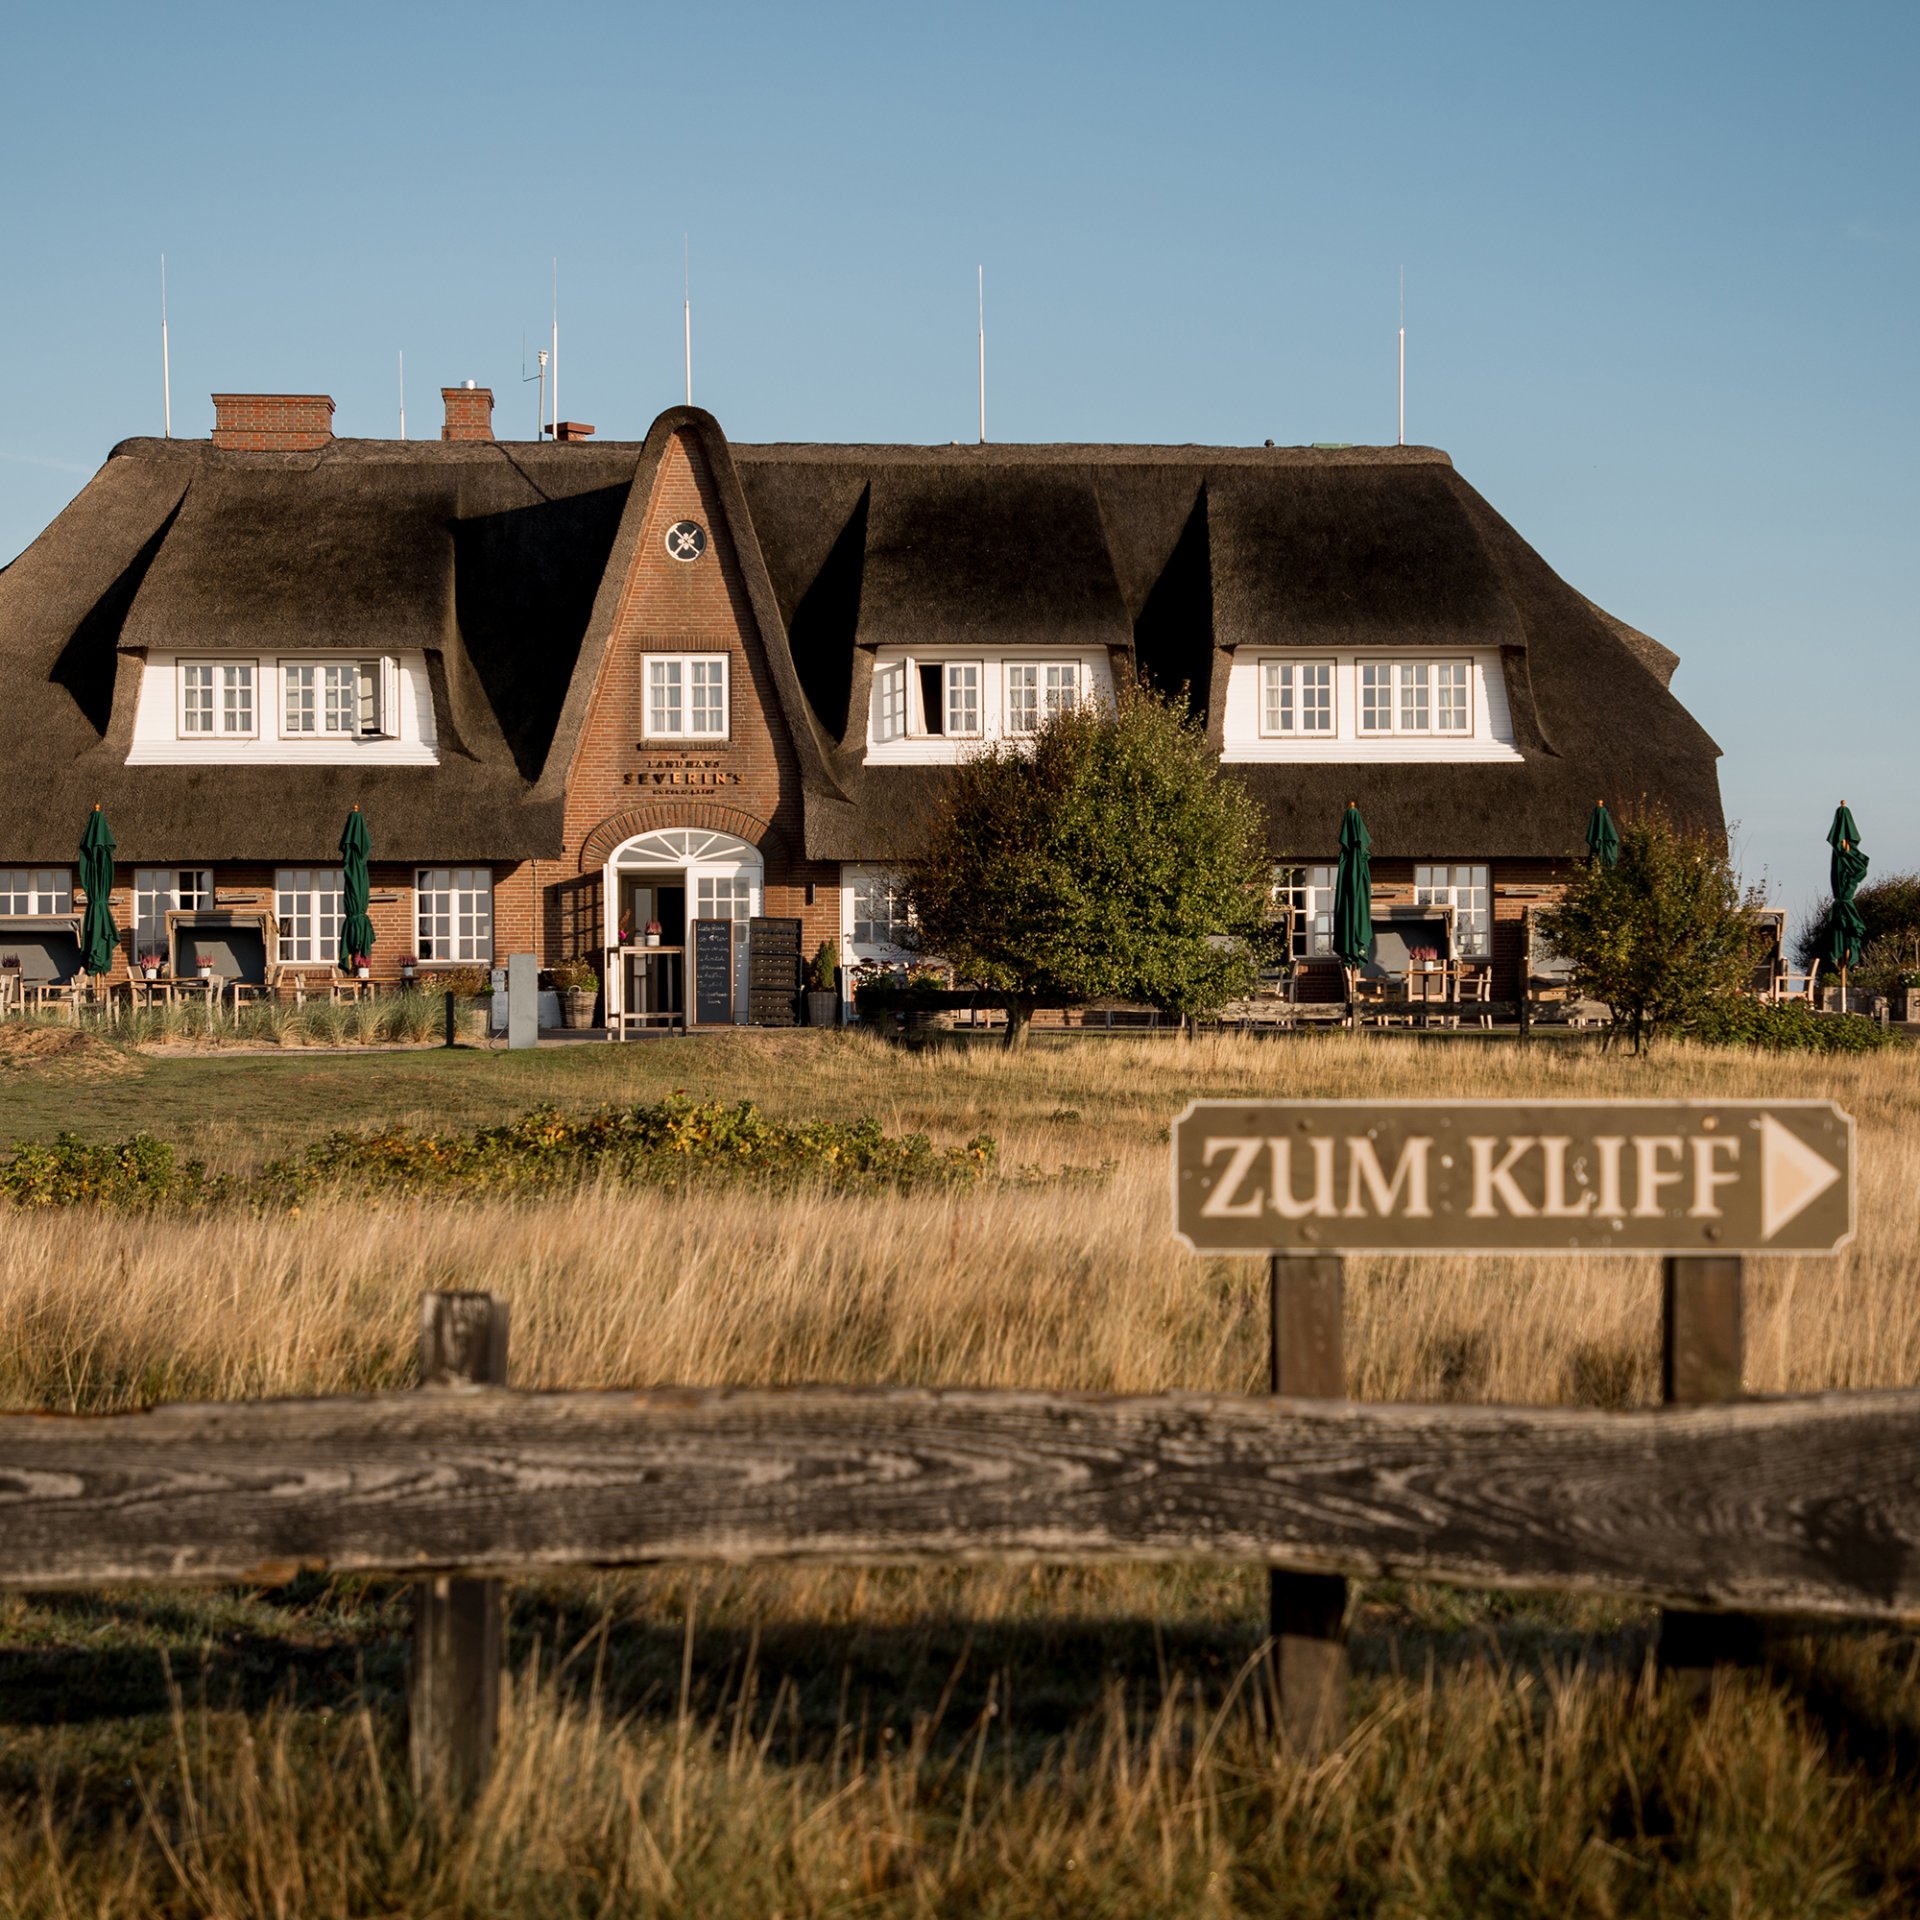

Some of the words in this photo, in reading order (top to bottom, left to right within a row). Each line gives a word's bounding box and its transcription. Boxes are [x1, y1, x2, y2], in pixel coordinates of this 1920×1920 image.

[647, 760, 720, 768] LANDHAUS
[623, 772, 744, 785] SEVERIN'S
[1199, 1136, 1434, 1219] ZUM
[1465, 1136, 1741, 1219] KLIFF
